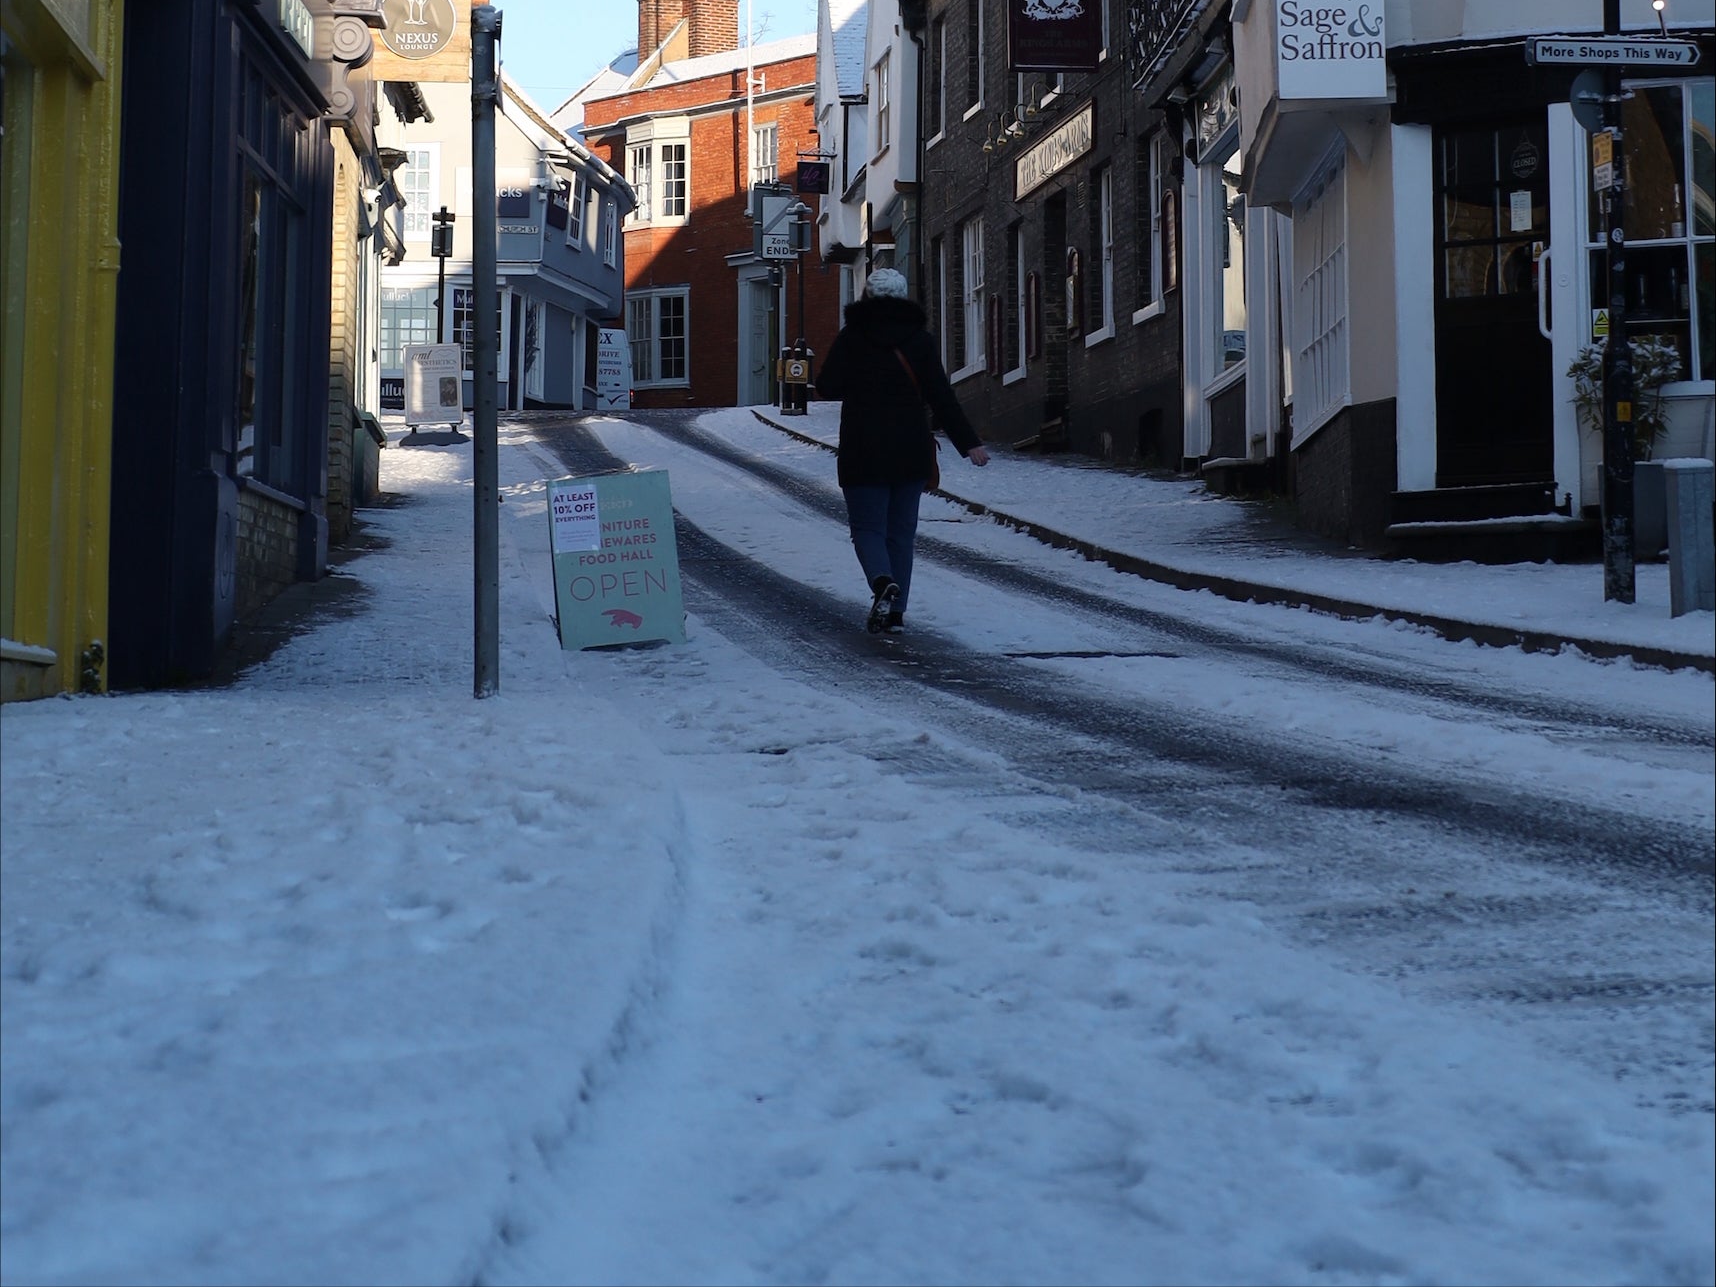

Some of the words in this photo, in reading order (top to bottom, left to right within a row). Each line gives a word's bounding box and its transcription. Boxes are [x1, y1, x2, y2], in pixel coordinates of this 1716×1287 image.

[1280, 0, 1346, 34] Sage
[1347, 4, 1383, 37] &
[395, 33, 438, 44] NEXUS
[1281, 33, 1384, 61] Saffron
[1542, 46, 1574, 57] More
[1579, 47, 1619, 60] Shops
[1624, 47, 1650, 59] This
[1655, 48, 1682, 61] Way
[1021, 154, 1036, 187] THE
[1064, 114, 1089, 156] ARMS
[766, 246, 790, 255] END
[553, 494, 565, 503] AT
[567, 492, 594, 502] LEAST
[554, 504, 572, 514] 10%
[574, 503, 595, 513] OFF
[555, 514, 596, 523] EVERYTHING
[601, 518, 650, 533] NITURE
[579, 553, 617, 566] FOOD
[621, 551, 654, 562] HALL
[570, 569, 667, 601] OPEN
